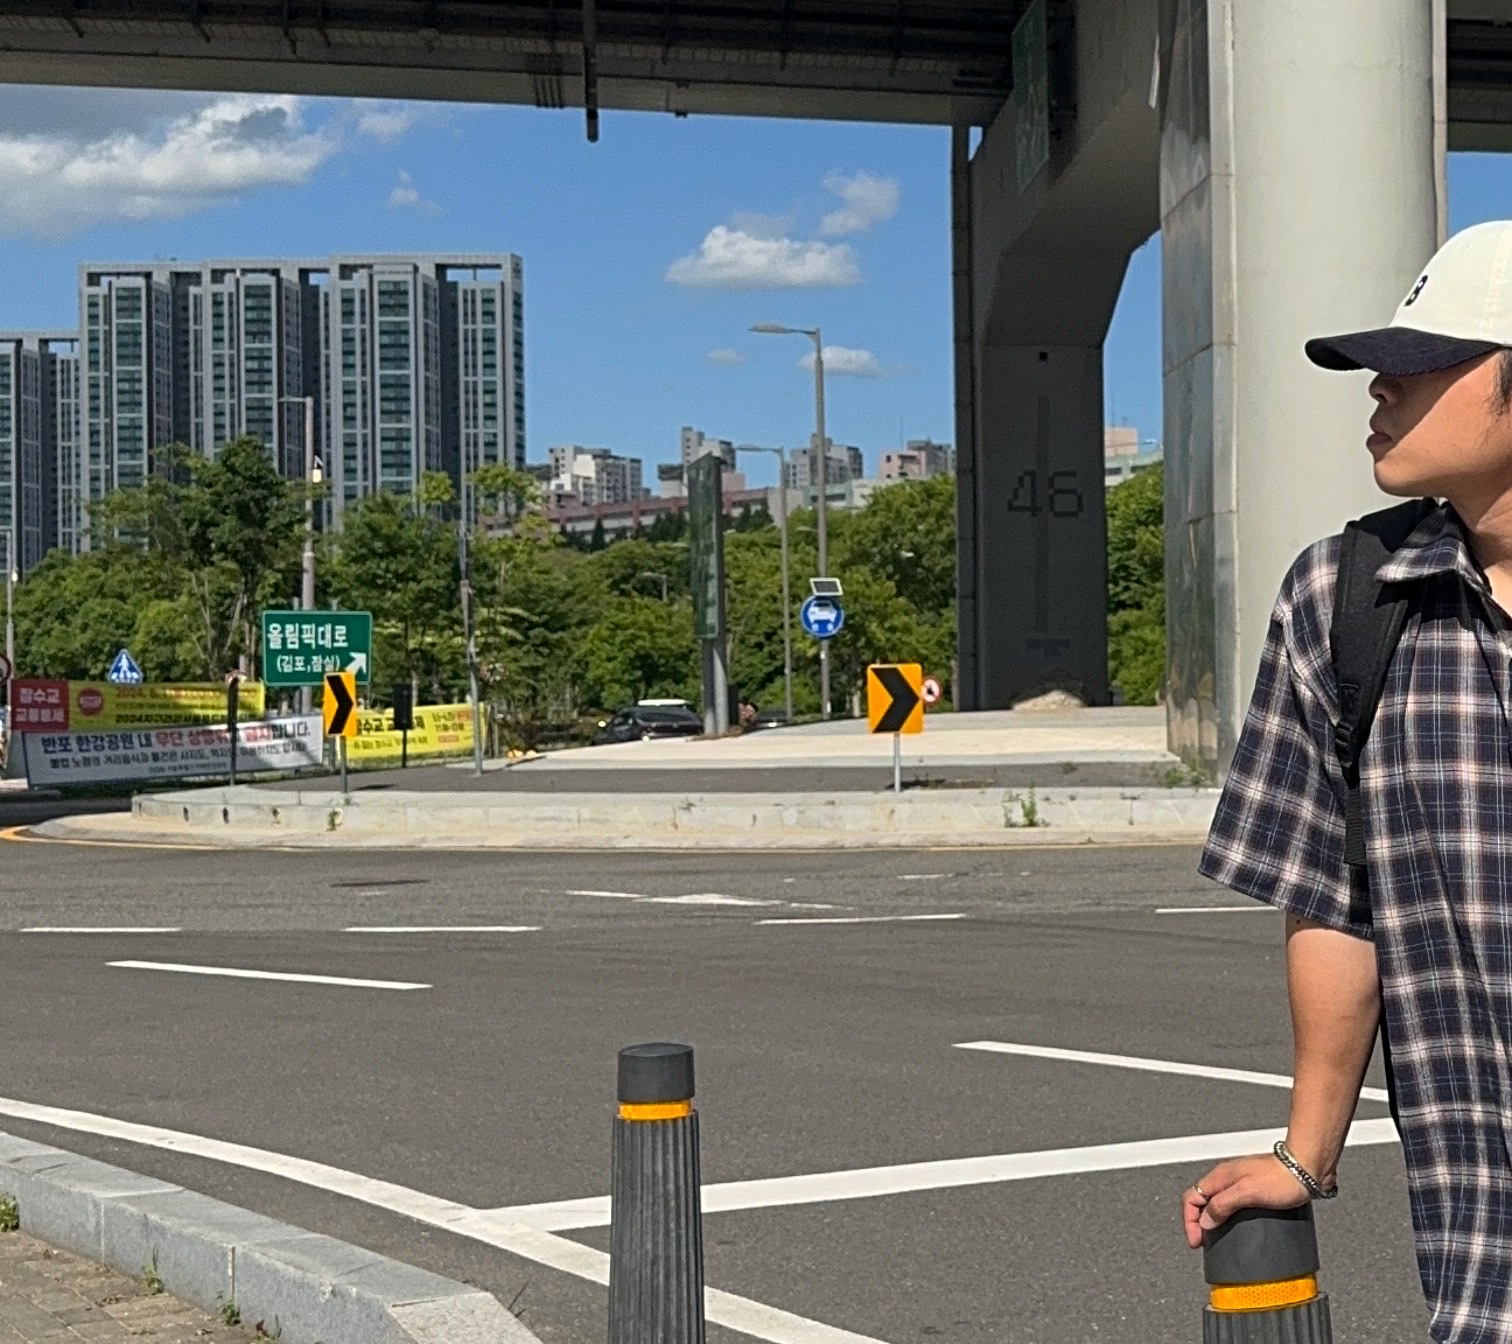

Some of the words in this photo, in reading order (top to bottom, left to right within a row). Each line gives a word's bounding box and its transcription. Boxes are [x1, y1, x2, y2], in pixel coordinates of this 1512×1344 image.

[1006, 469, 1084, 517] 46
[267, 622, 349, 650] 올림픽대로
[276, 654, 341, 673] (김포,잠실)
[41, 736, 73, 754] 반포
[75, 733, 135, 753] 한강공원
[137, 732, 153, 748] 내
